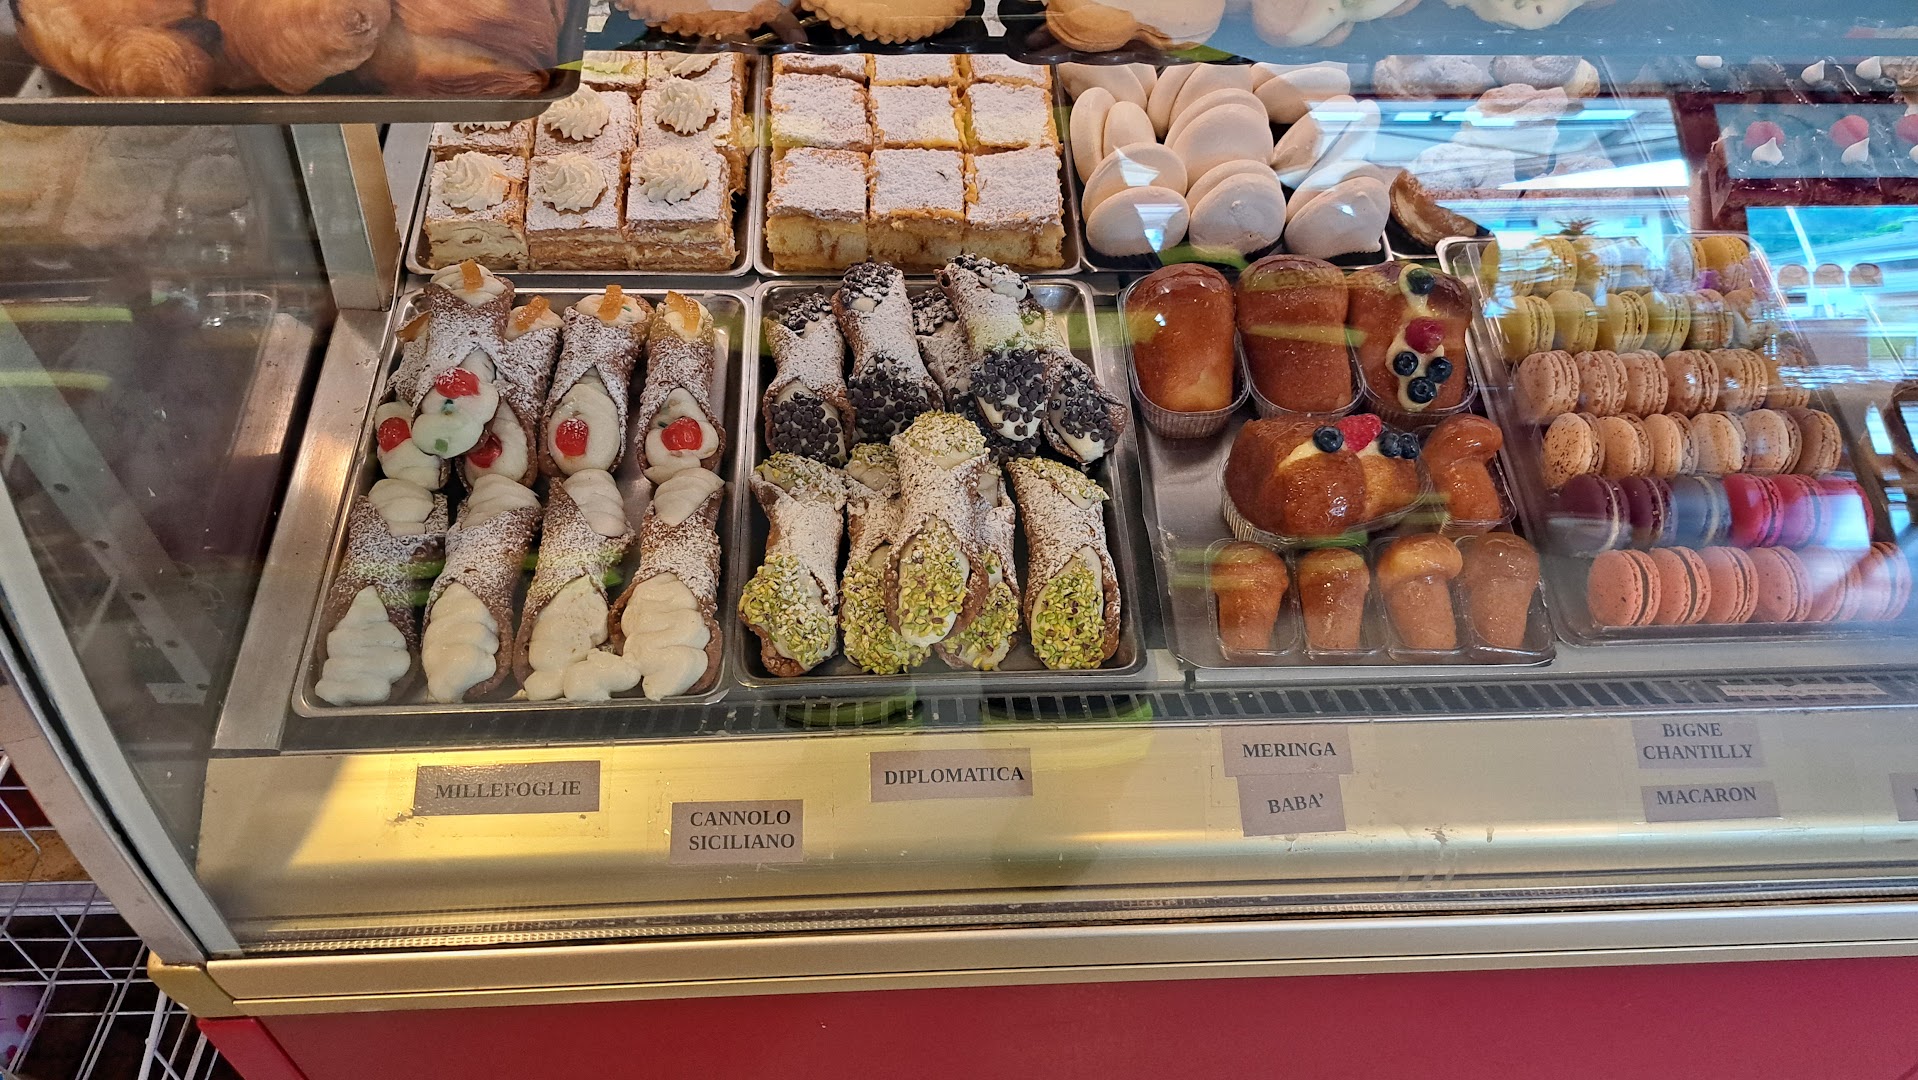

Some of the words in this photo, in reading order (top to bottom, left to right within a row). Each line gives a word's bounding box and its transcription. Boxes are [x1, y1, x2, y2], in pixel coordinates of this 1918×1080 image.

[1662, 722, 1723, 737] BIGNE
[1242, 742, 1337, 758] MERINGA
[1643, 744, 1753, 760] CHANTILLY
[884, 766, 1025, 785] DIPLOMATICA
[435, 780, 581, 799] MILLEFOGLIE
[1656, 786, 1757, 805] MACARON
[1267, 793, 1324, 814] BABA'
[690, 810, 791, 826] CANNOLO
[689, 834, 795, 850] SICILIANO
